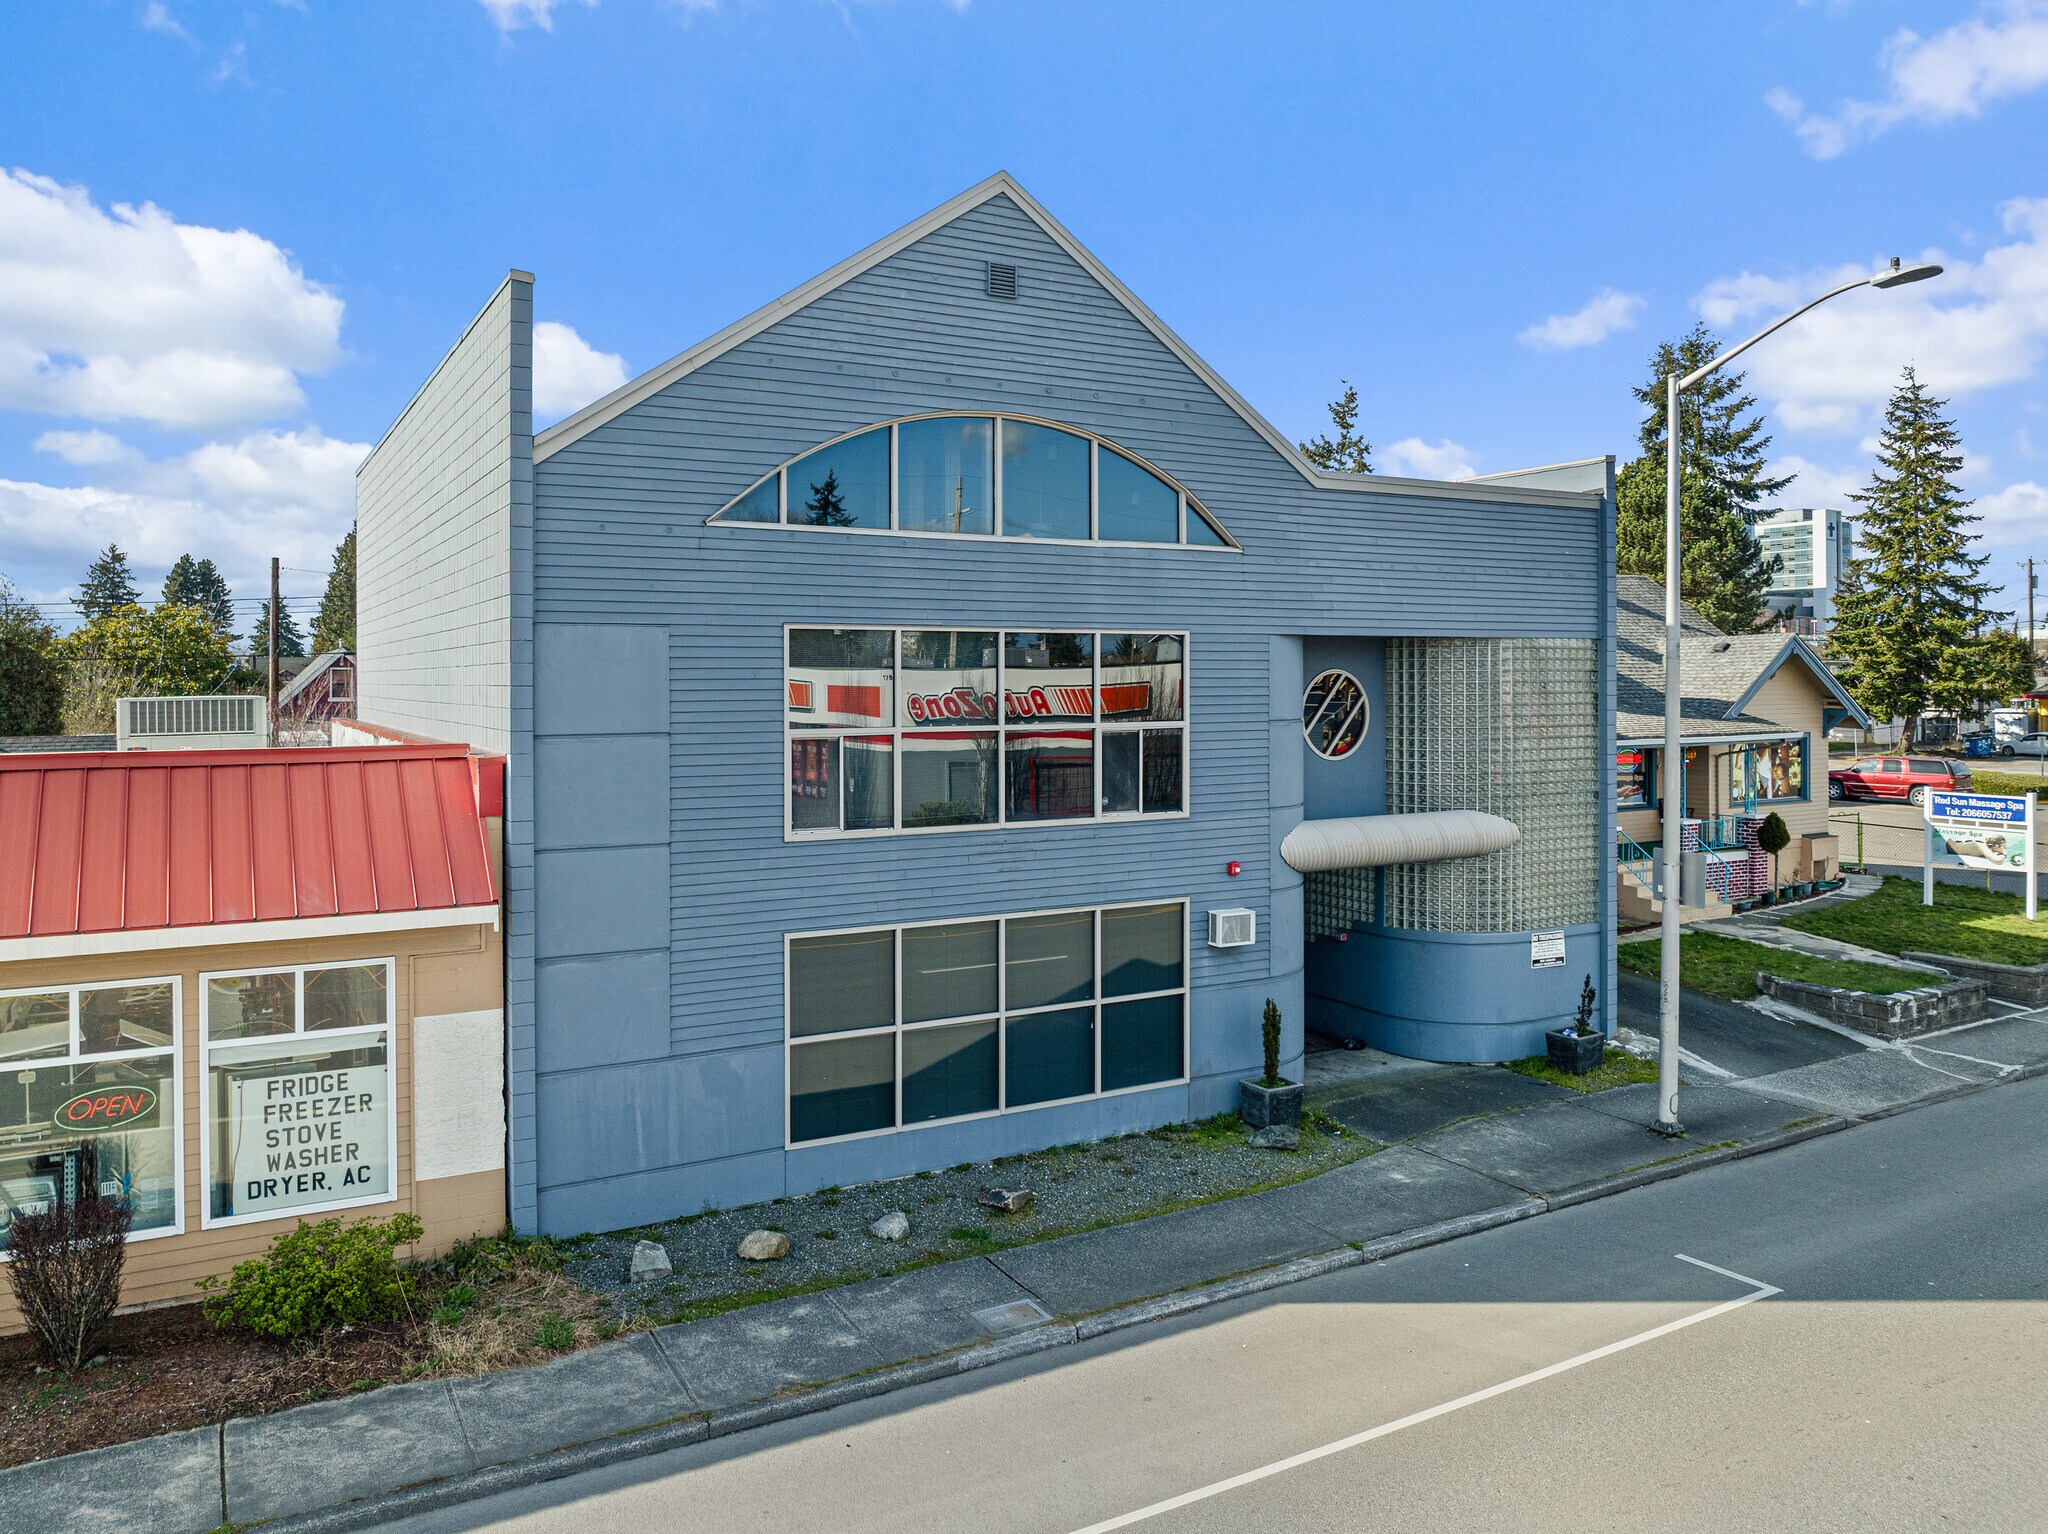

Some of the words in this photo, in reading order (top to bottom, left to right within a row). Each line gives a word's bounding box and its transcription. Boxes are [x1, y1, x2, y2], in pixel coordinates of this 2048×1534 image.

[1934, 795, 1951, 805] Red
[1951, 797, 1968, 806] Sun
[1968, 798, 2006, 810] Massage
[2006, 800, 2024, 812] Spa
[1944, 807, 1961, 817] Tel:
[1961, 808, 2013, 820] 2066057537
[1968, 830, 1983, 838] Spa
[266, 1072, 349, 1100] FRIDGE
[67, 1093, 144, 1120] OPEN
[263, 1093, 373, 1124] FREEZER
[265, 1121, 342, 1148] STOVE
[266, 1142, 360, 1173] WASHER
[342, 1165, 371, 1187] AC
